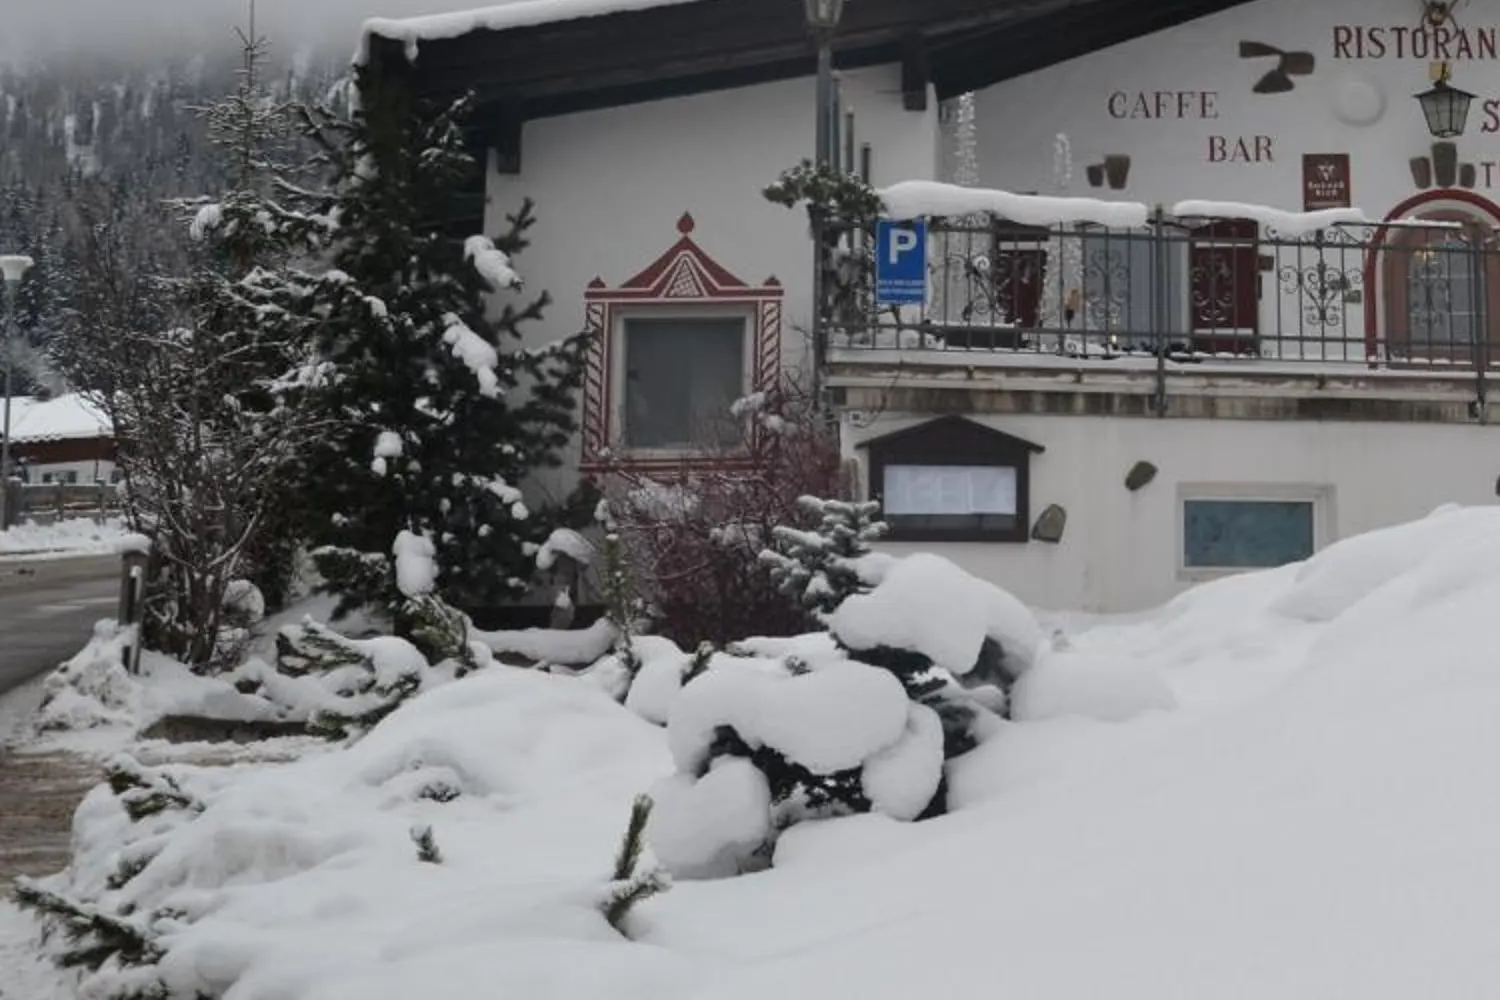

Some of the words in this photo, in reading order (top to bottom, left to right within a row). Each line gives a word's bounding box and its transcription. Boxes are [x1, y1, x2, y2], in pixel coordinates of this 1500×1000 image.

[1107, 89, 1220, 120] CAFFE
[1207, 134, 1274, 163] BAR
[888, 227, 918, 265] P
